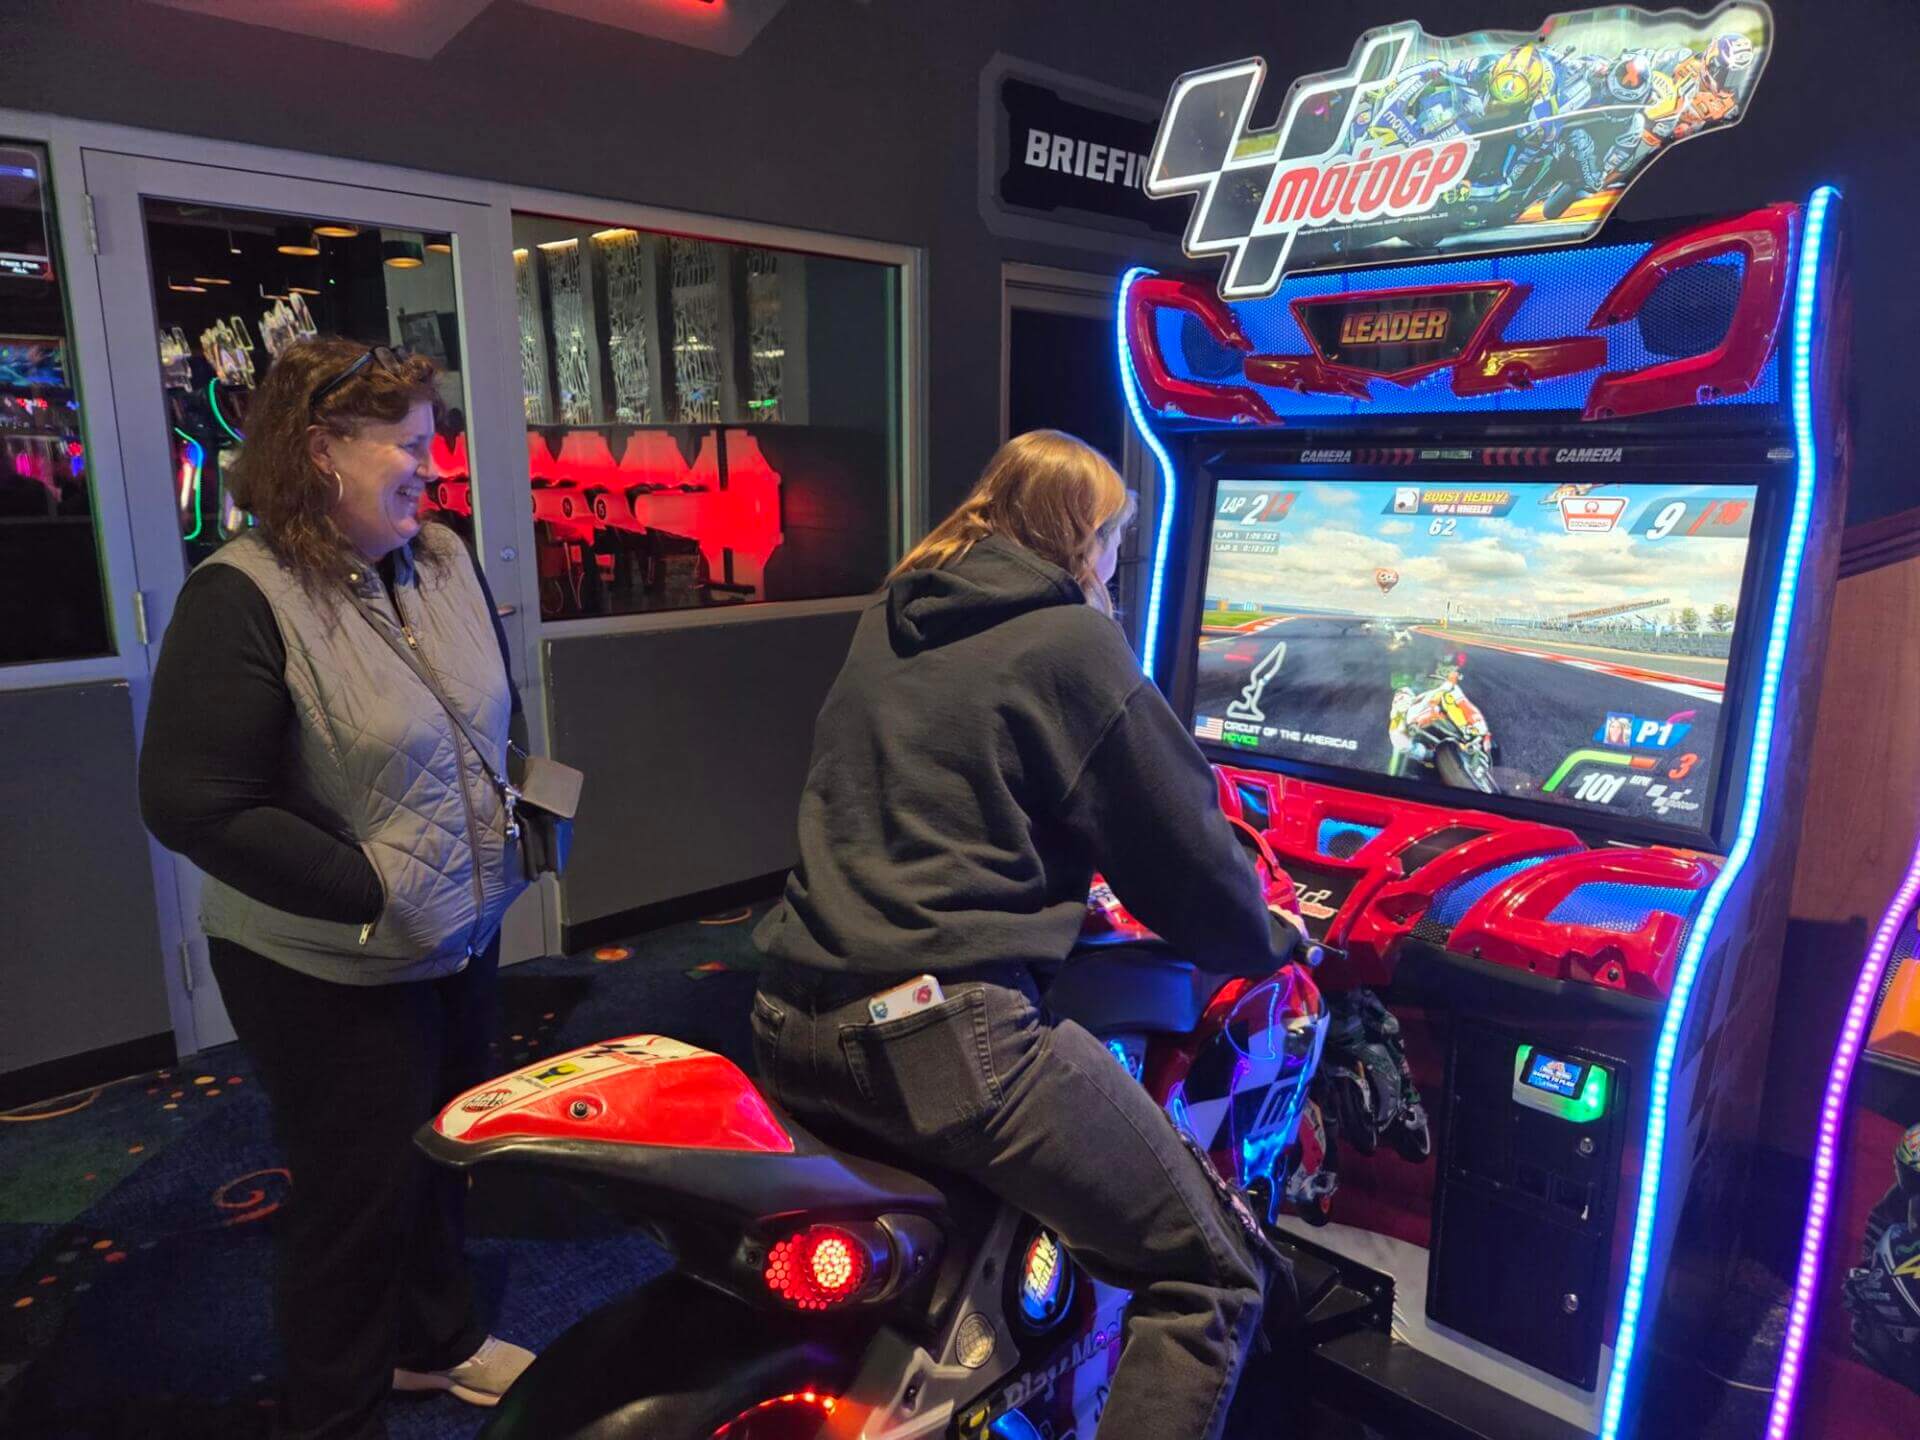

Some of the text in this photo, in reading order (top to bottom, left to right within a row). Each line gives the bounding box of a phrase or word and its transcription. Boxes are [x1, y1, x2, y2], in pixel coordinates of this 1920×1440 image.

[1341, 309, 1448, 344] LEADER
[1300, 450, 1351, 463] CAMERA
[1555, 448, 1623, 463] CAMERA
[1219, 496, 1247, 513] LAP
[1423, 490, 1460, 502] BOOST
[1428, 518, 1457, 537] 62
[1222, 732, 1259, 746] NOVICE
[1224, 720, 1358, 750] CIRCUIT OF THE AMERICAS
[1635, 720, 1674, 746] P1
[1668, 753, 1698, 780] 3
[1574, 772, 1627, 804] 101
